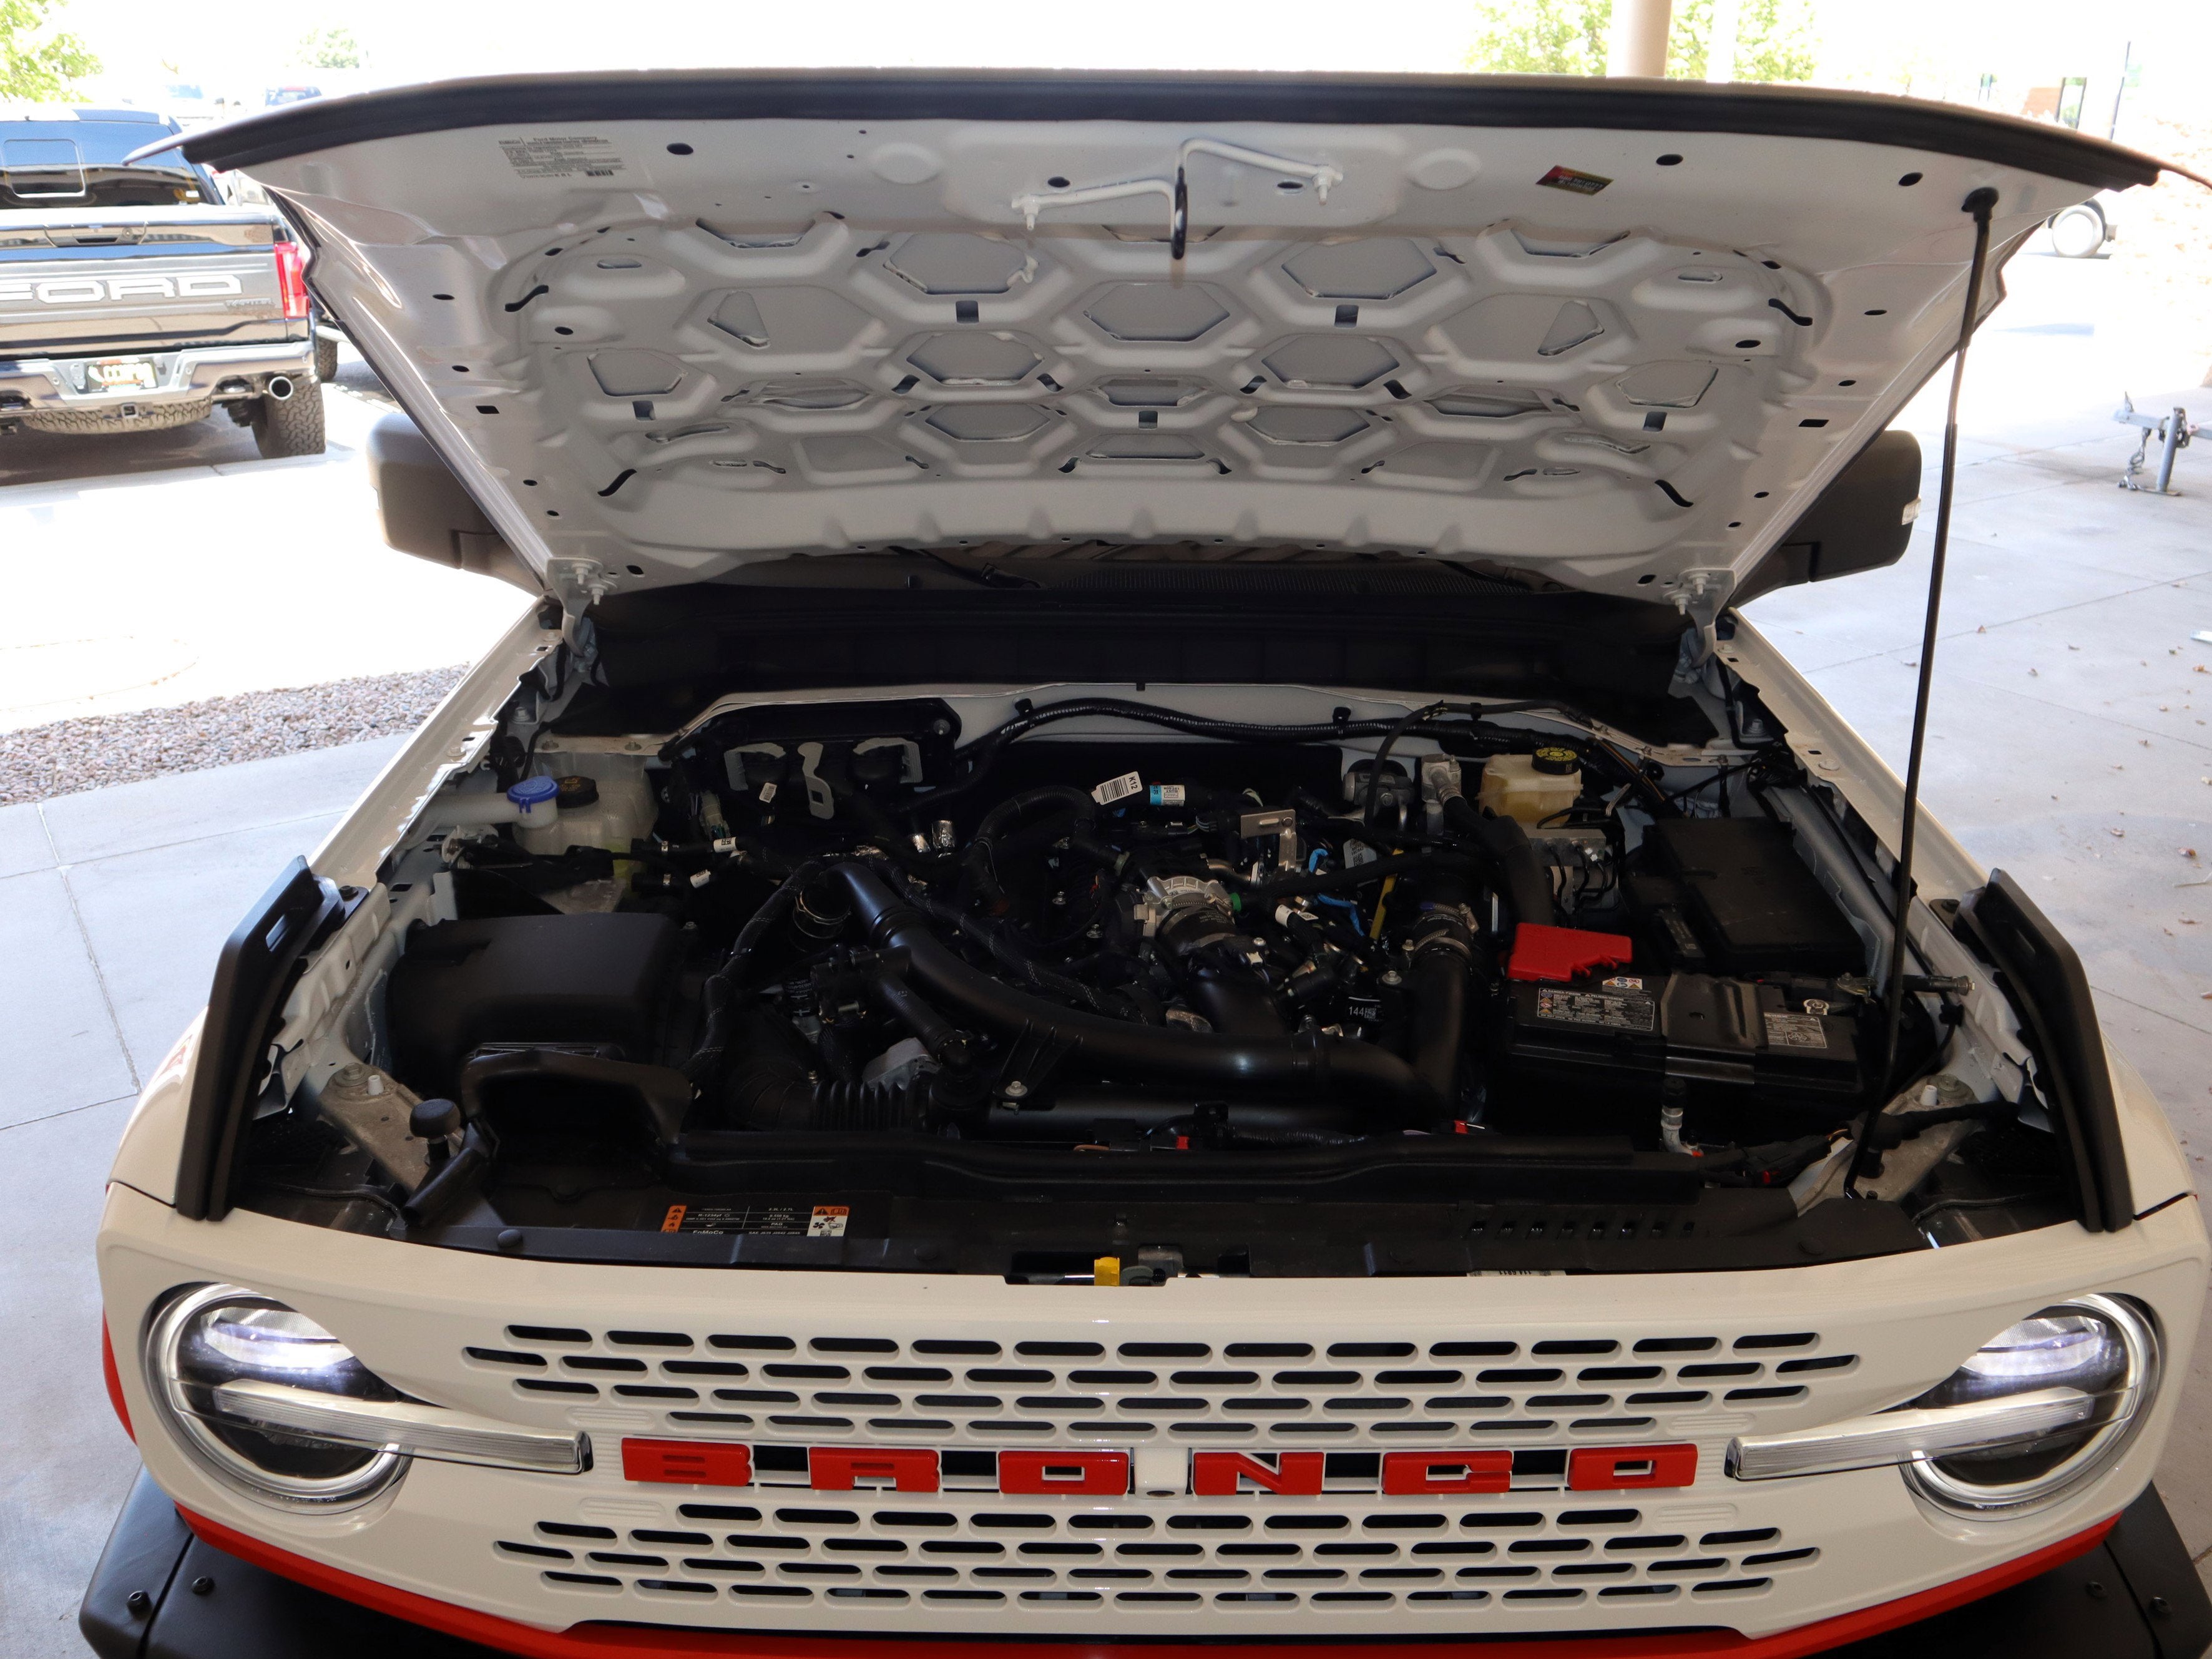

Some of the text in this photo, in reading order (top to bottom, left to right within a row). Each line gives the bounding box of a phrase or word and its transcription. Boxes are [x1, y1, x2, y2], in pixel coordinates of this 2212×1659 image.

[1128, 776, 1138, 790] K12
[1349, 1006, 1364, 1017] 144
[622, 1438, 1698, 1495] BRONCO
